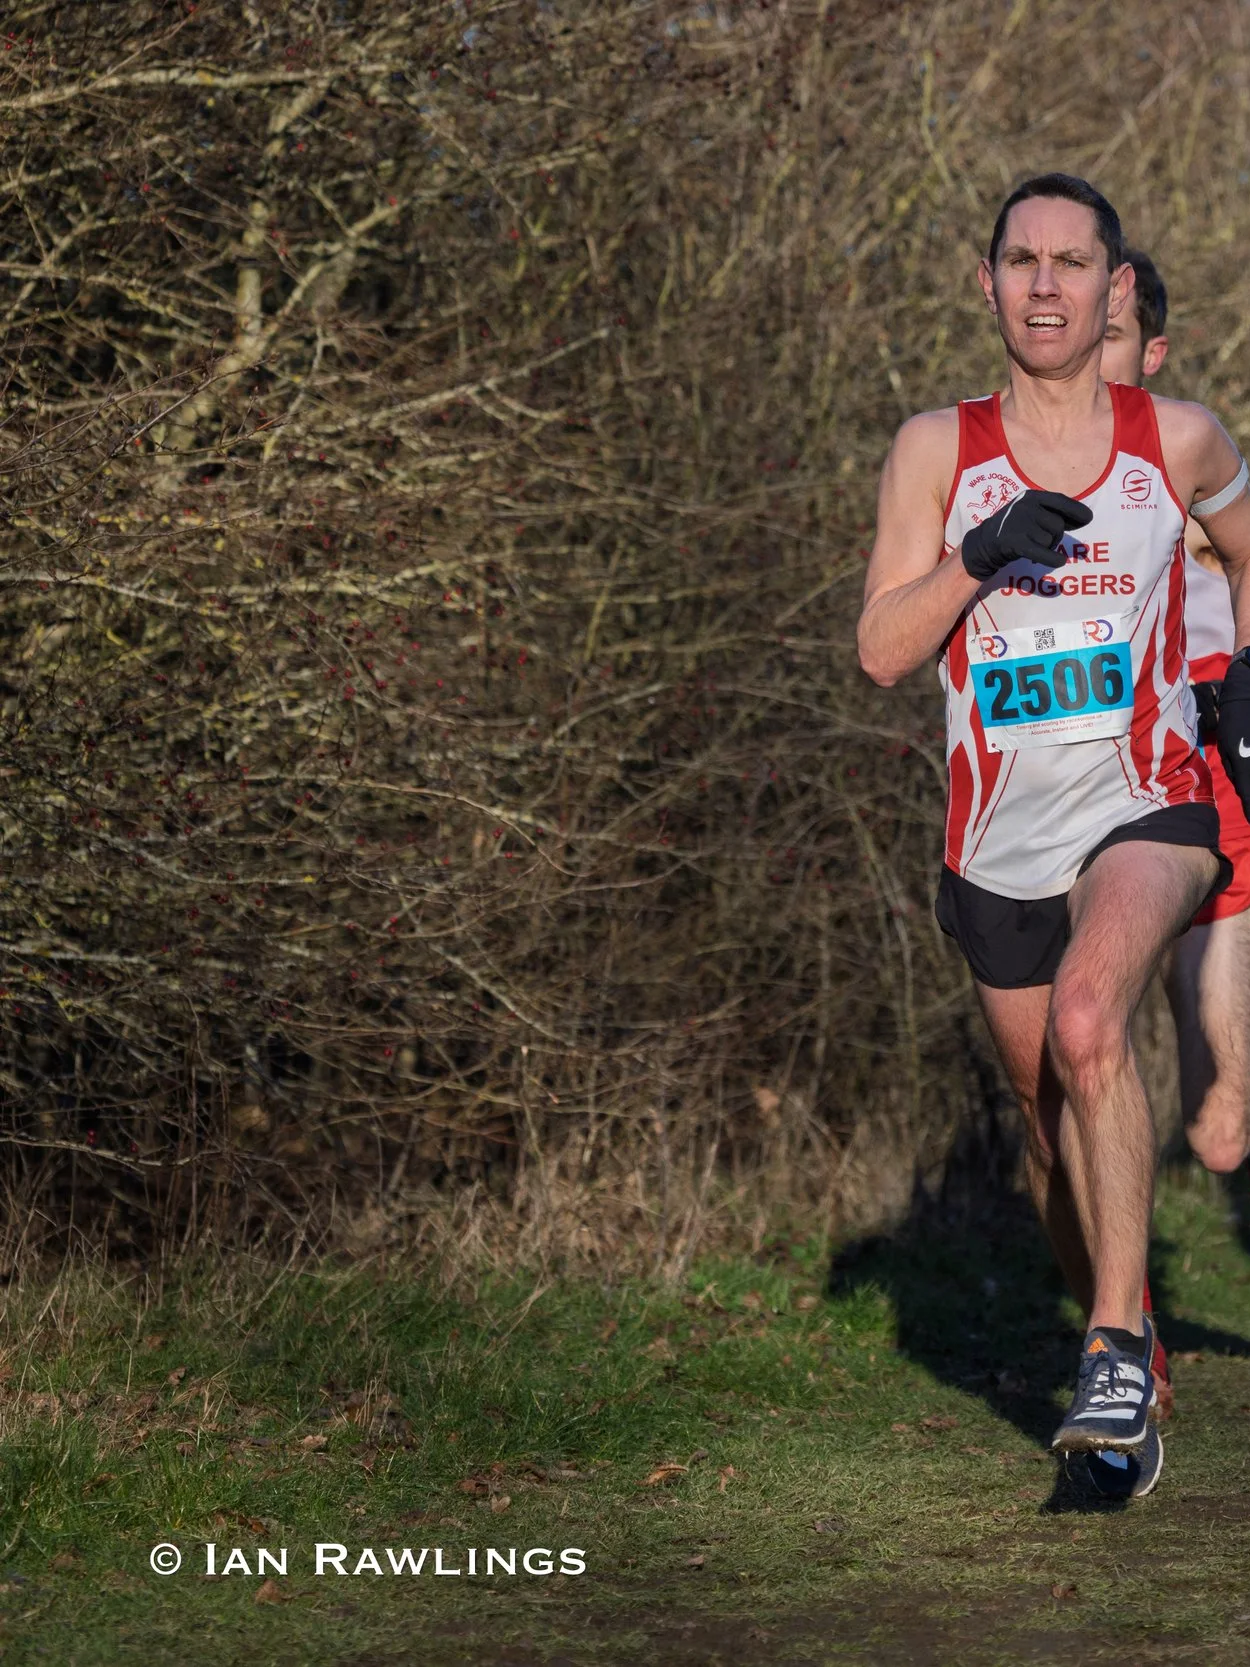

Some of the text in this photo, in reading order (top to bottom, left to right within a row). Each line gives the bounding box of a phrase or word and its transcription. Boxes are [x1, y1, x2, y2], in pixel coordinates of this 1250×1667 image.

[968, 473, 1020, 492] WARE JOGGERS
[1052, 542, 1109, 564] ARE
[1000, 573, 1136, 597] JOGGERS
[984, 652, 1124, 721] 2506
